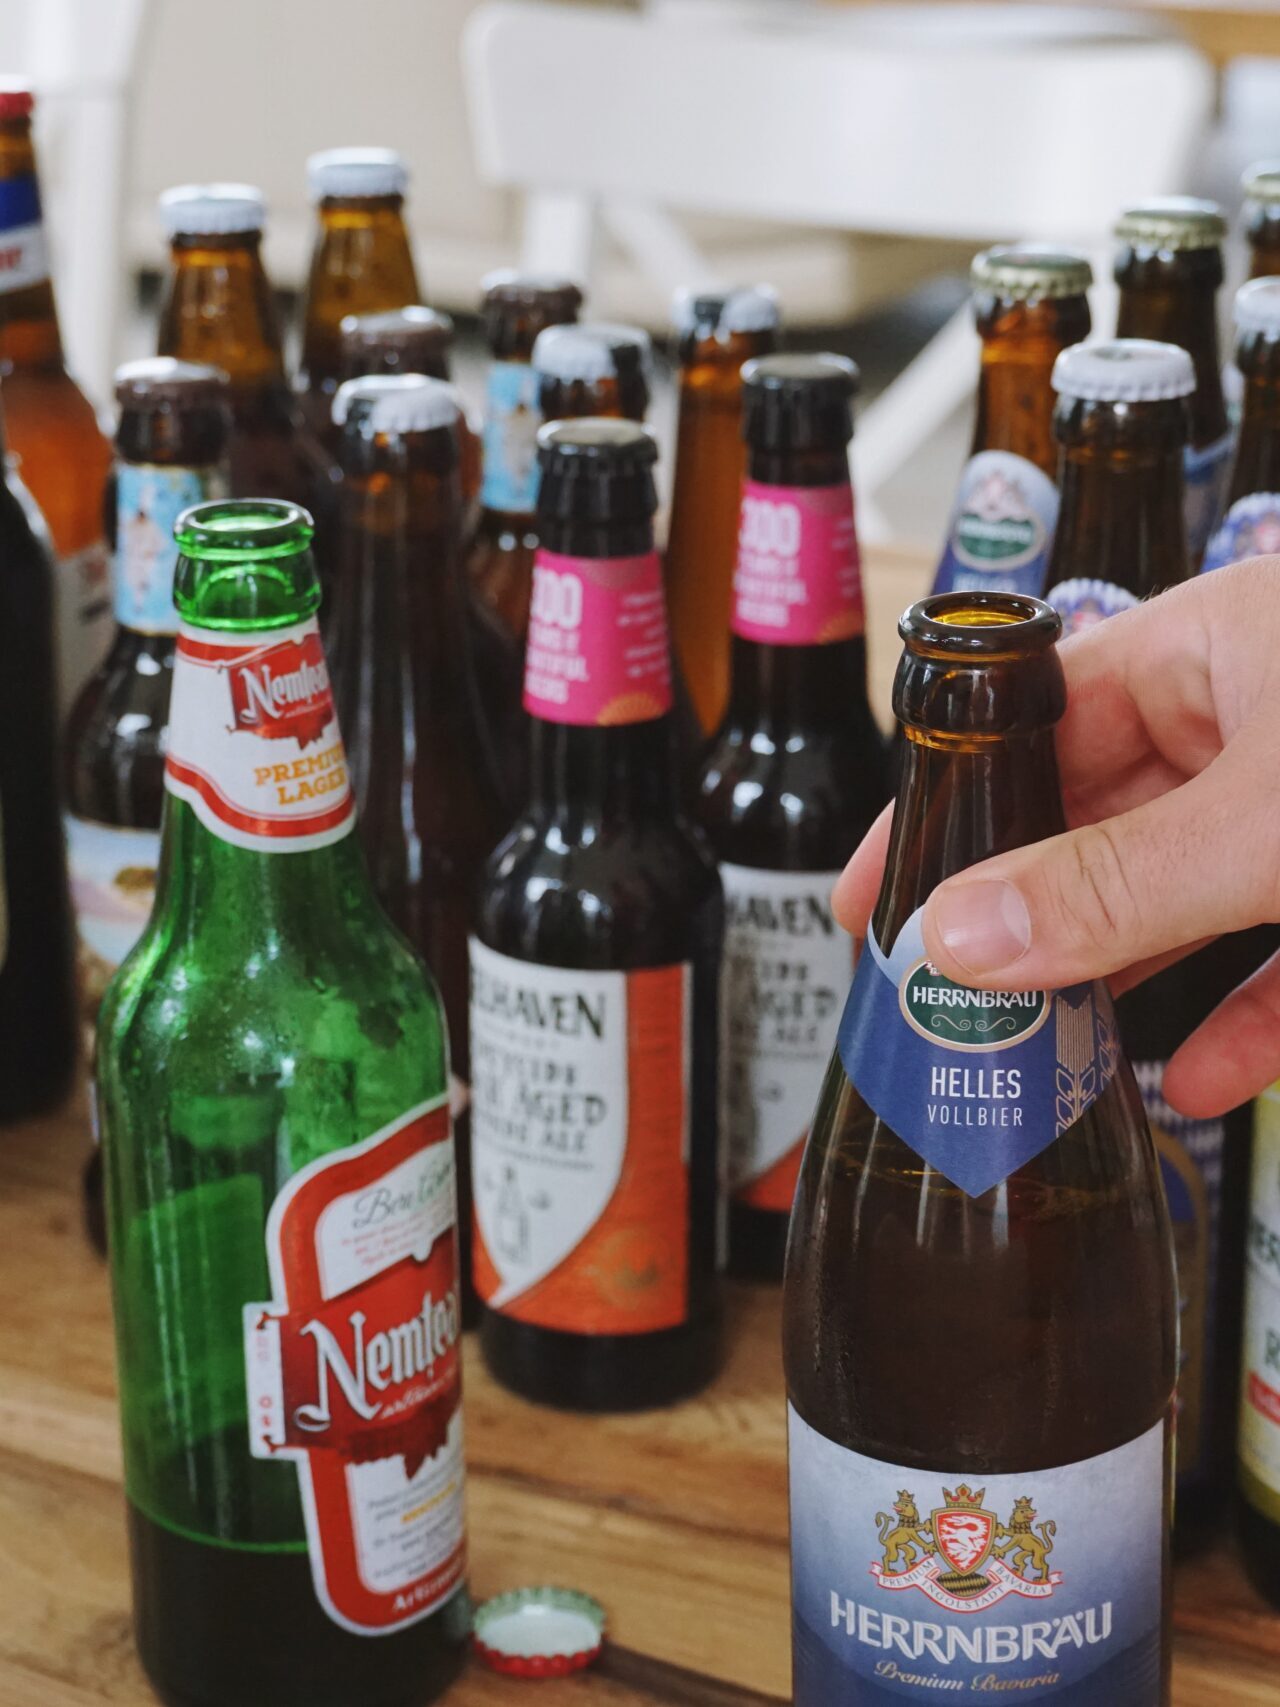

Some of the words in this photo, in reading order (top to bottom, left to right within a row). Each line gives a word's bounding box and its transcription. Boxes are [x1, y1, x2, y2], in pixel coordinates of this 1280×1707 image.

[930, 1066, 1022, 1099] HELLES
[927, 1103, 1023, 1127] VOLLBIER
[881, 1560, 935, 1586] PREMIUM
[921, 1579, 1006, 1610] INGOLSTADT
[995, 1566, 1047, 1595] BAVARIA
[829, 1588, 1113, 1665] HERRNBRÄU
[873, 1660, 964, 1692] Premium
[969, 1670, 1061, 1692] Bavaria
